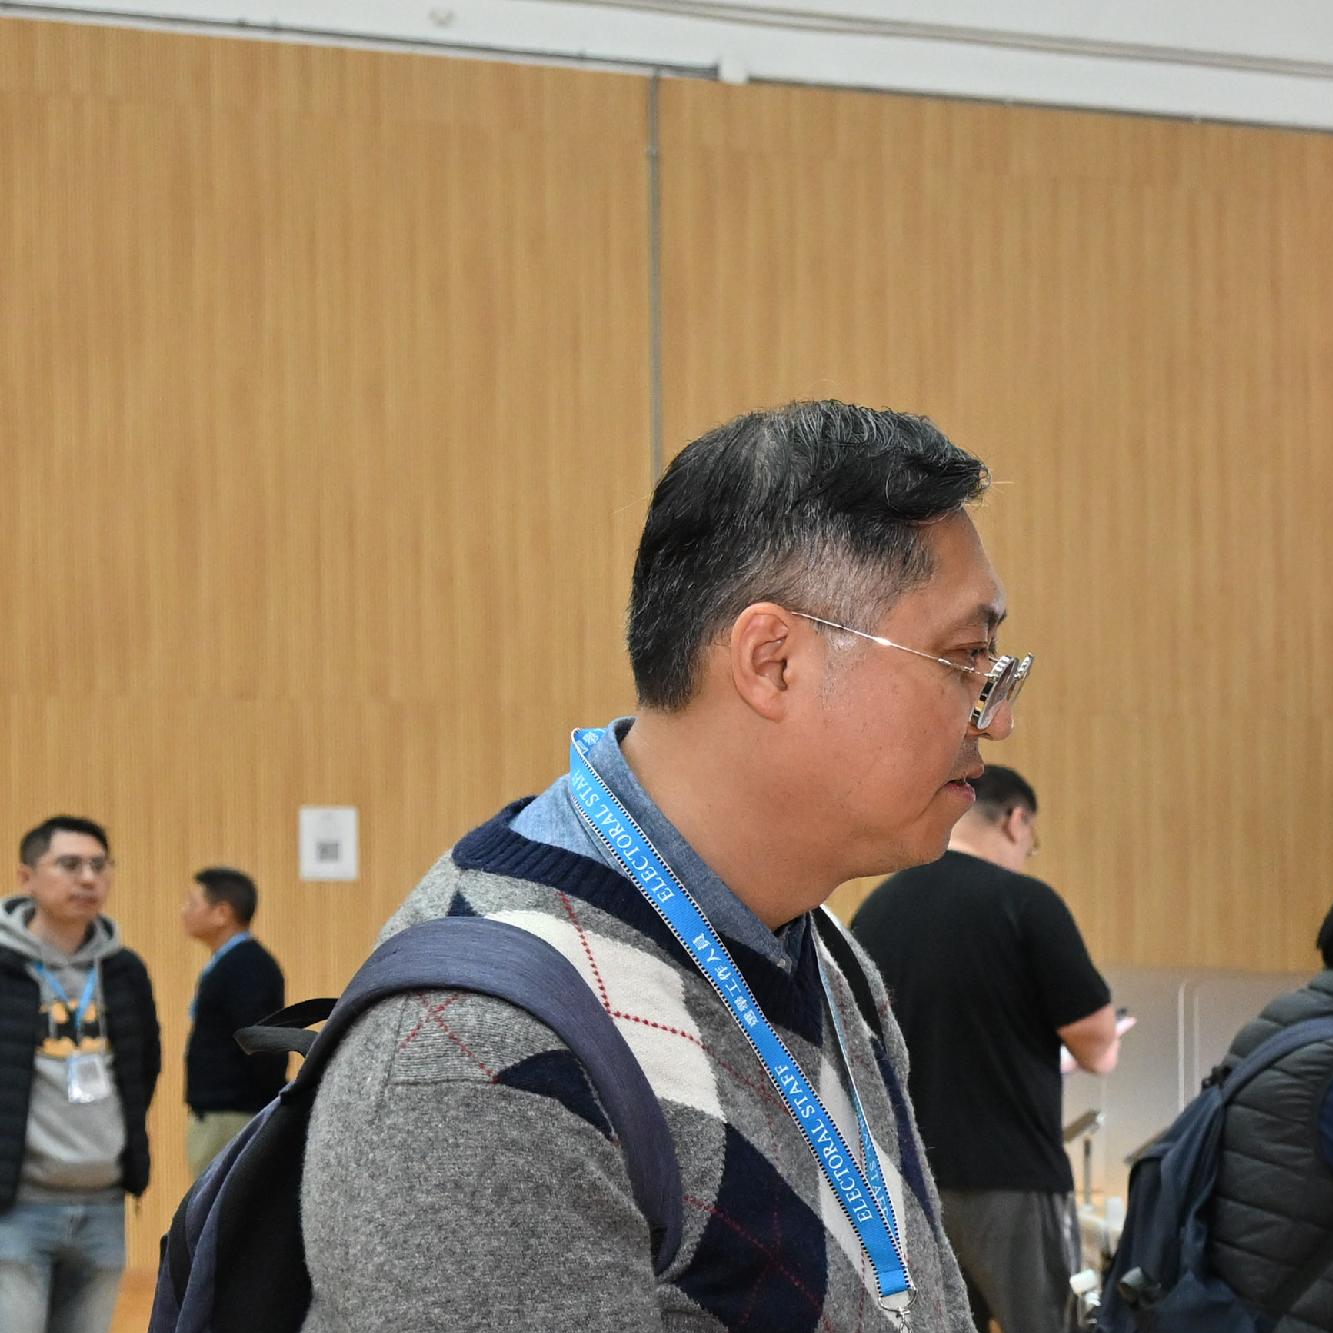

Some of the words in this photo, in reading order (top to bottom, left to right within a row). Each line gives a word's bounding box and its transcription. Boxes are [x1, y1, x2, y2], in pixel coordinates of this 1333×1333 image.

[596, 802, 675, 903] ELECTORAL
[774, 1063, 815, 1119] STAFF
[811, 1119, 874, 1223] ELECTORAL
